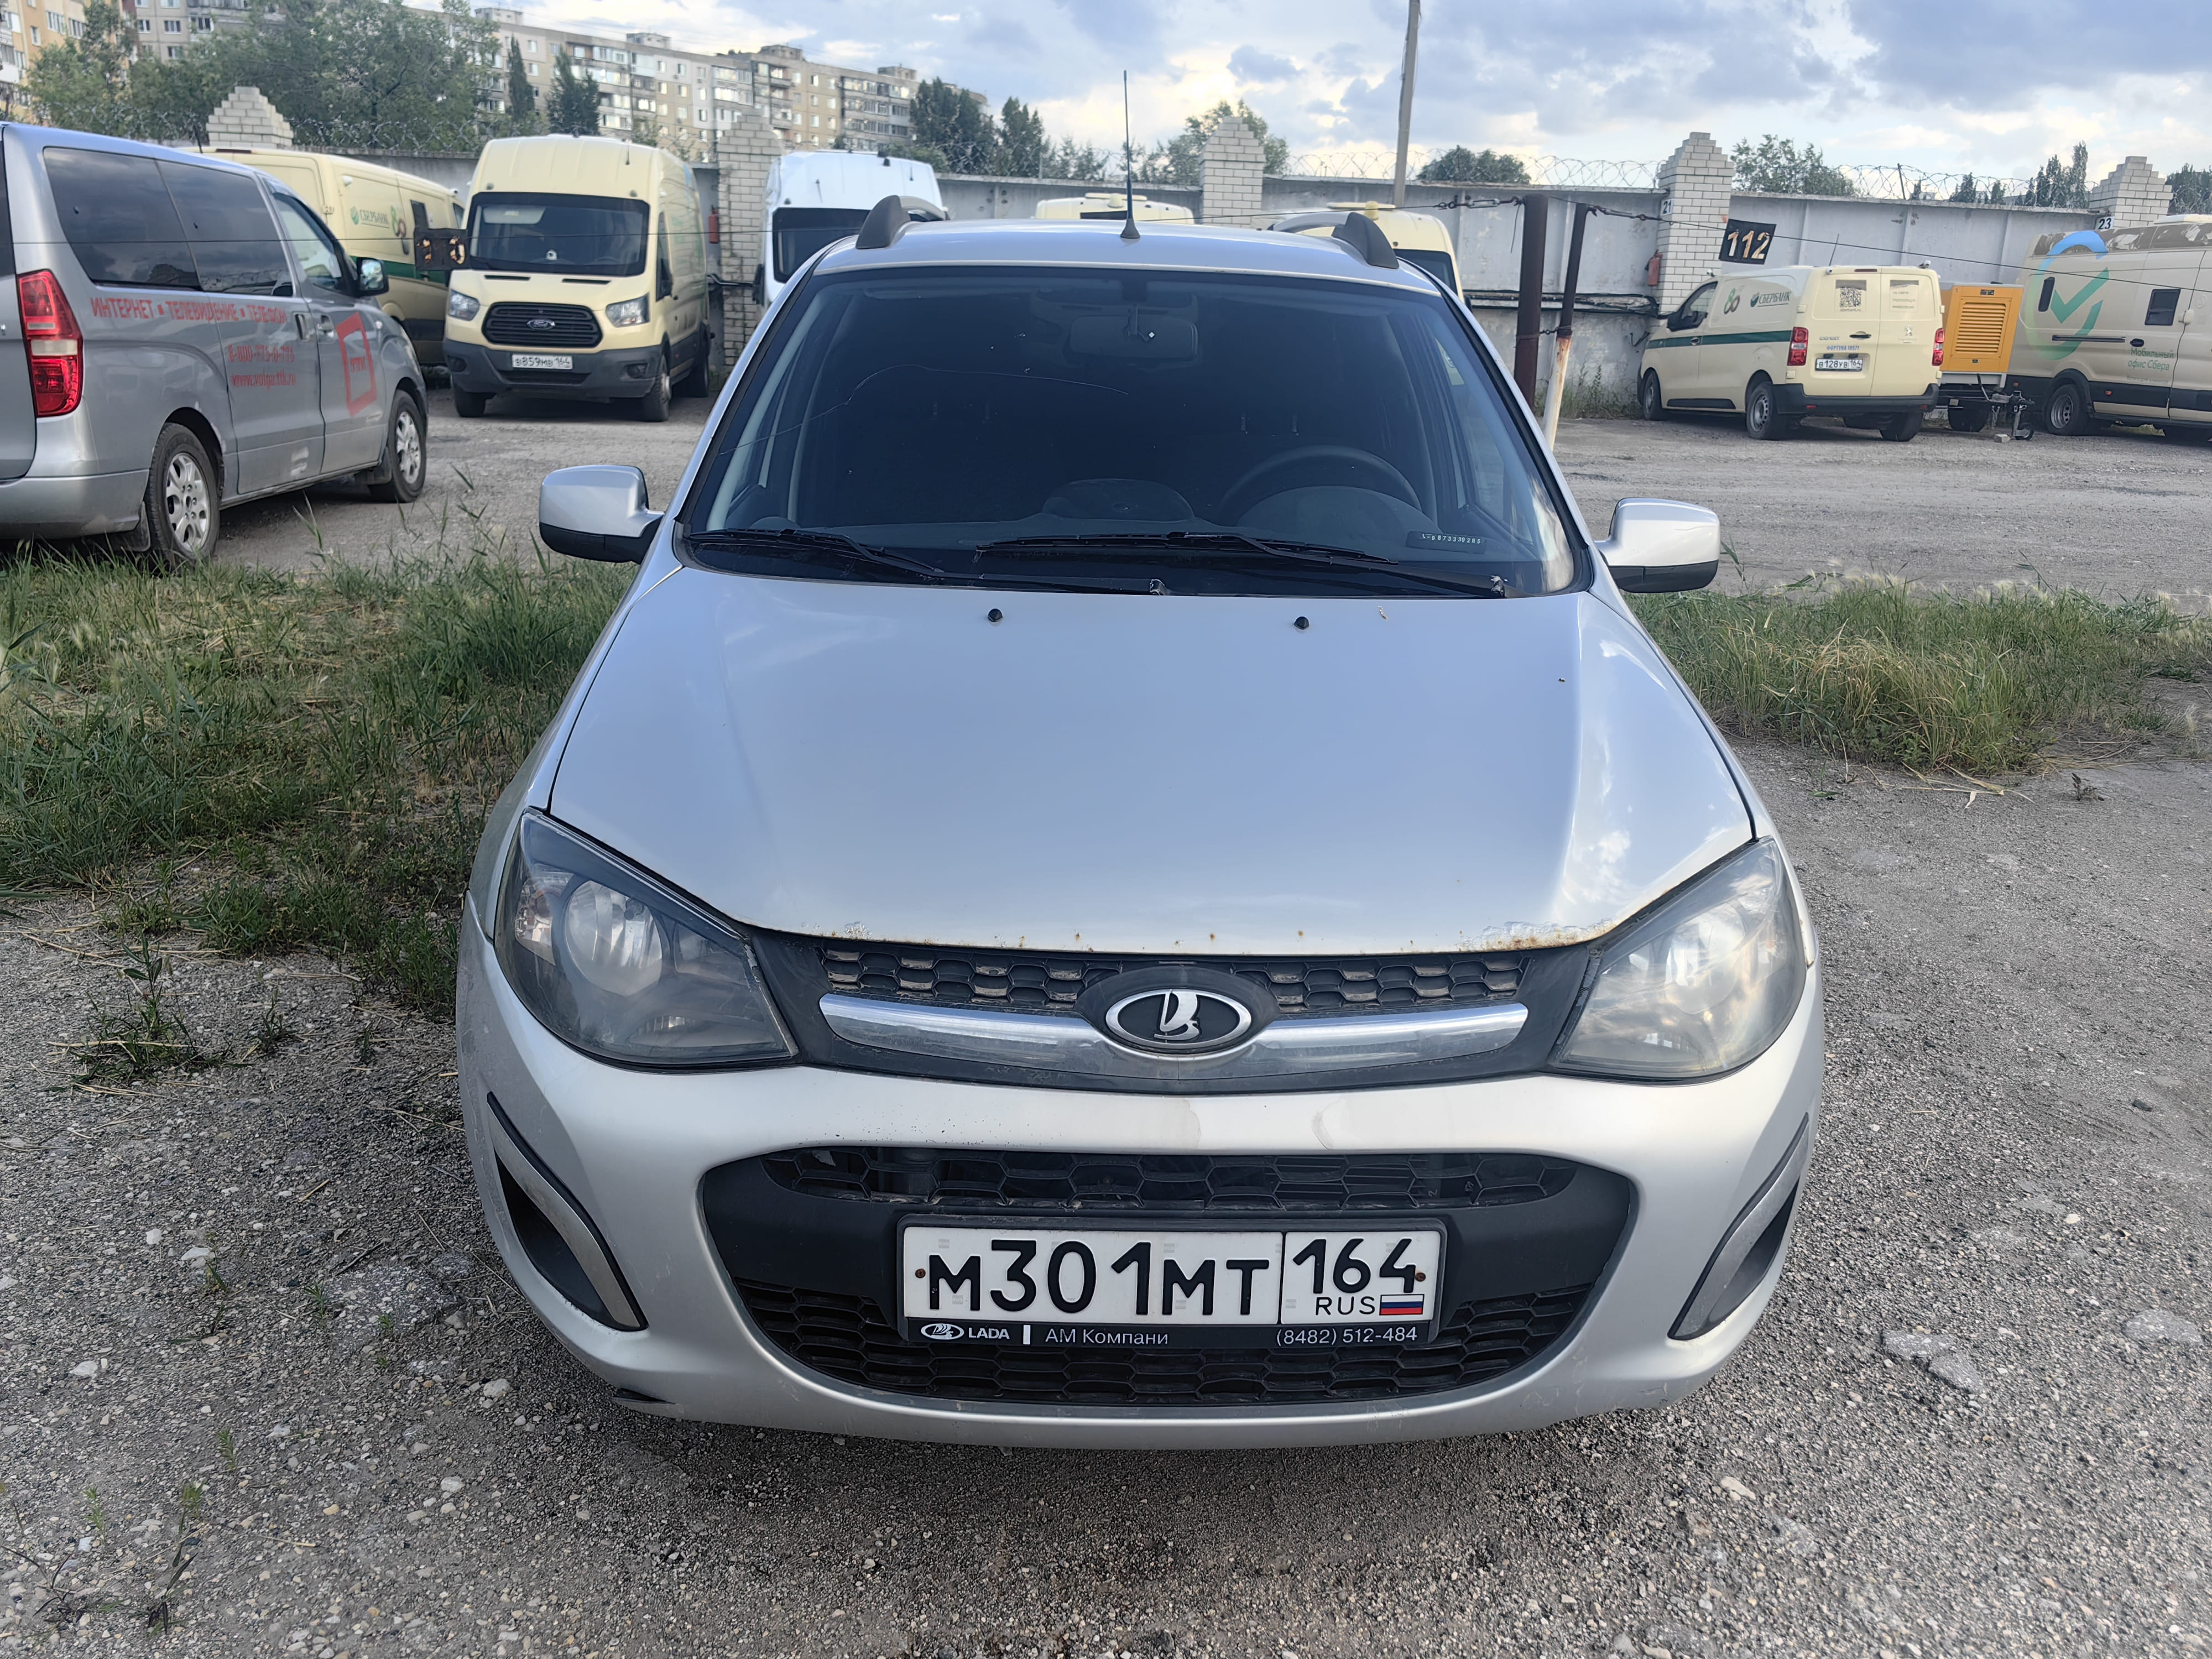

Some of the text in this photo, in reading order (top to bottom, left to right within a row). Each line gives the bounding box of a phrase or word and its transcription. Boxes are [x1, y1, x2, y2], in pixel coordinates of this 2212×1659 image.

[1663, 201, 1672, 214] 21
[2098, 218, 2112, 229] 23
[1728, 230, 1770, 259] 112
[1759, 291, 1790, 304] СБЕРБАНК
[90, 297, 154, 319] ИНТЕРНЕТ
[165, 301, 239, 322] ТЕЛЕВИДЕНИЕ
[2130, 347, 2174, 358] Мобильный
[2128, 358, 2170, 372] офис Сбера
[929, 1238, 1416, 1316] М301МТ 164
[1316, 1296, 1375, 1316] RUS
[968, 1327, 1010, 1340] LADA
[1045, 1328, 1168, 1345] АМ Компани
[1276, 1327, 1417, 1347] (8482) 512-484
